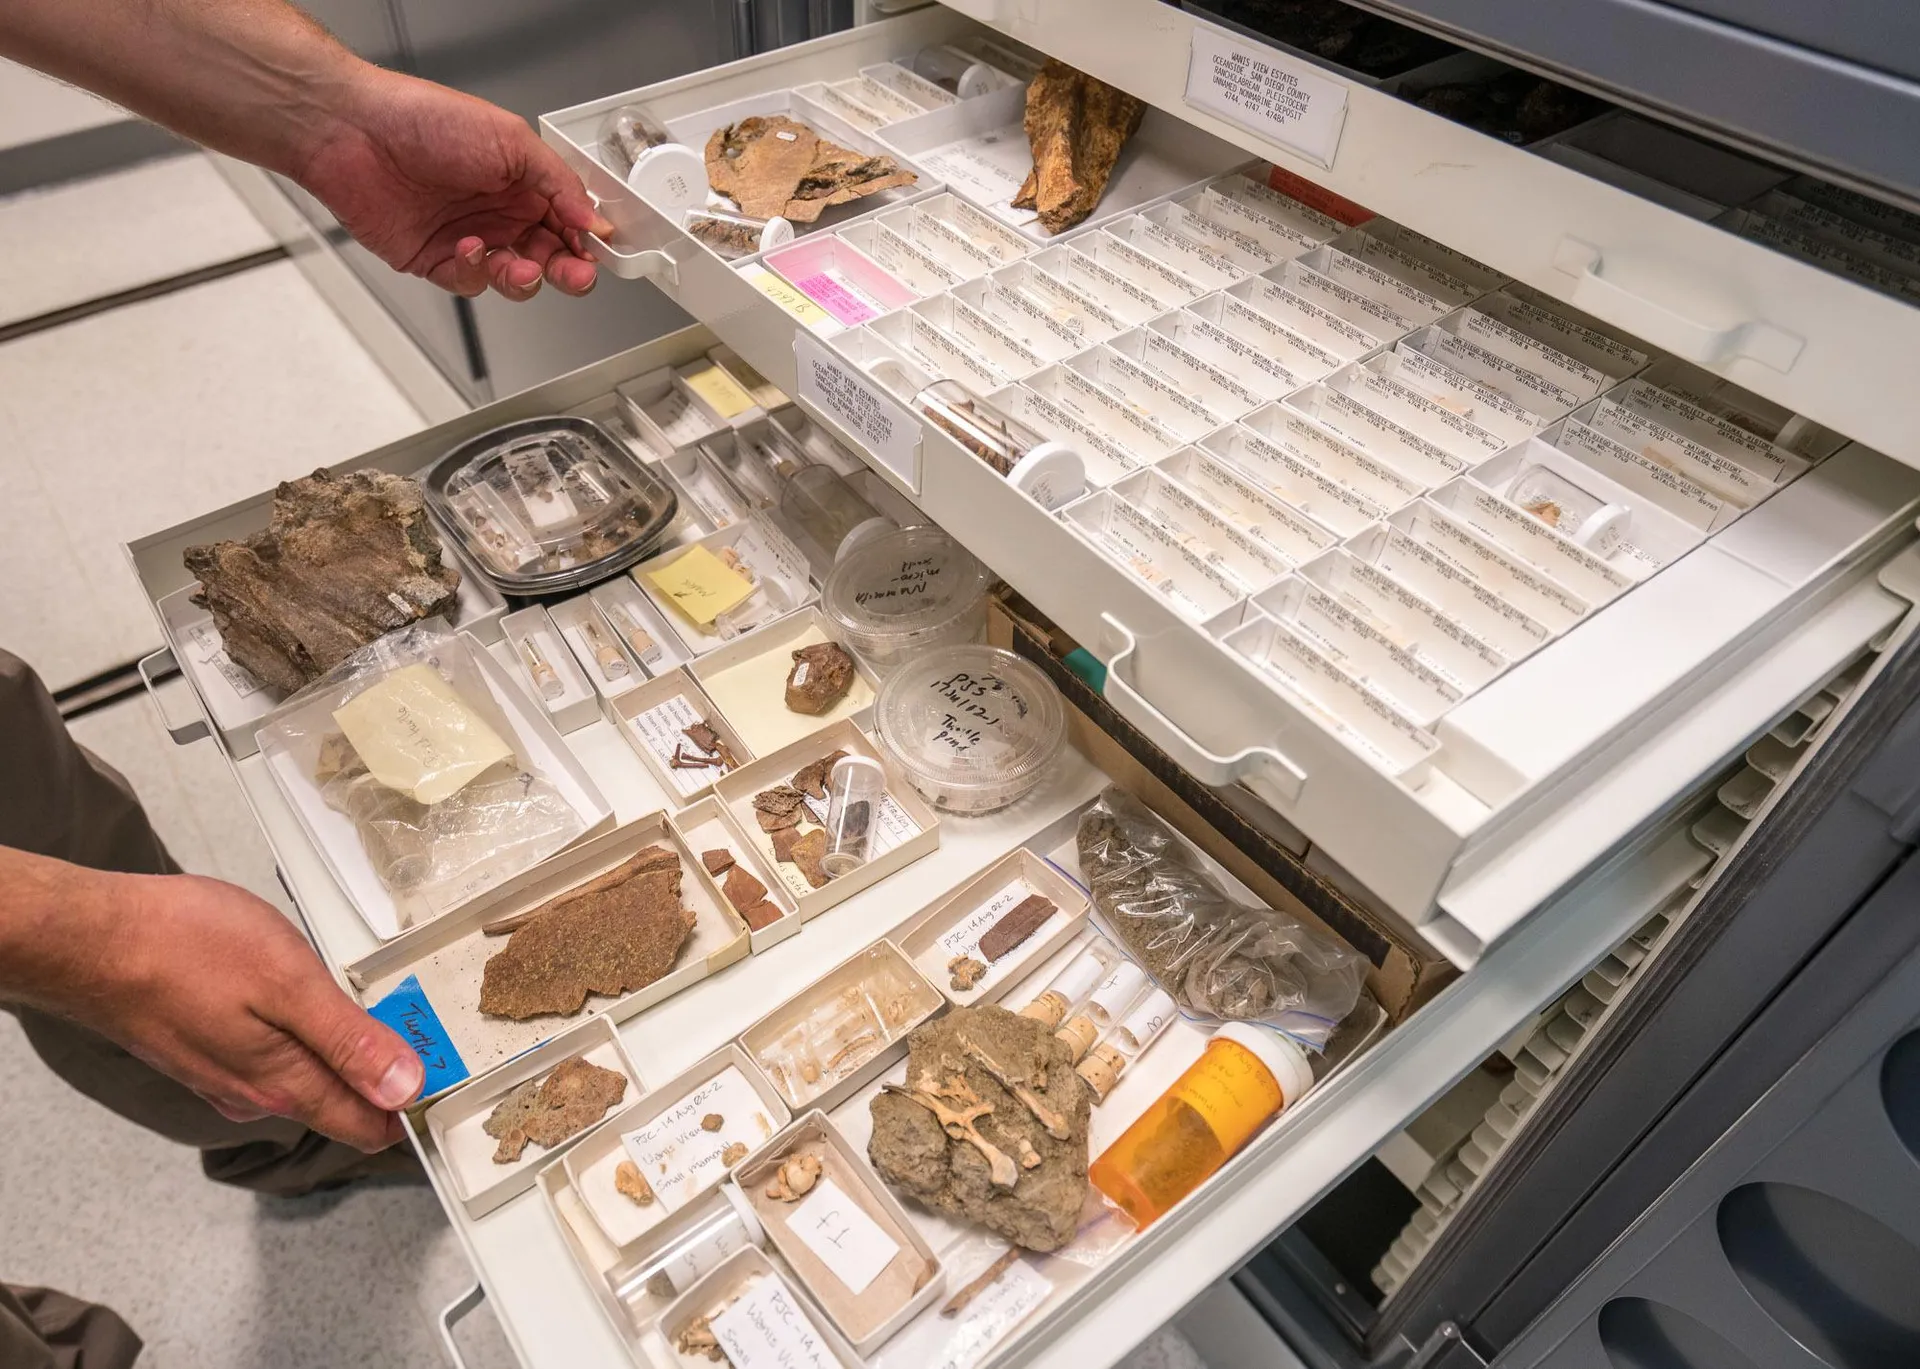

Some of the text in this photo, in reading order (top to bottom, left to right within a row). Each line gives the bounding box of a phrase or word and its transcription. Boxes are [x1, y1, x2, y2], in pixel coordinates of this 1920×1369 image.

[1231, 53, 1297, 87] WANIS VIEW ESTATES
[1250, 70, 1262, 82] SAN
[1264, 76, 1285, 92] DIEGO
[1286, 85, 1310, 103] COUNTY
[1212, 75, 1301, 121] UNNAMED NONMARINE DEPOSIT
[1265, 88, 1308, 113] PLEISTOCENE
[1452, 336, 1462, 344] SAN
[1463, 342, 1479, 353] DIEGO
[1481, 351, 1503, 365] SOCIETY
[1514, 368, 1536, 382] NATURAL
[1539, 380, 1563, 395] HISTORY
[1480, 315, 1490, 323] SAN
[1491, 320, 1507, 332] DIEGO
[1509, 329, 1531, 343] SOCIETY
[1541, 346, 1563, 360] NATURAL
[1566, 358, 1589, 373] HISTORY
[826, 362, 880, 410] WANIS VIEW ESTATES
[843, 383, 853, 397] SAN
[855, 393, 871, 412] DIEGO
[873, 408, 892, 428] COUNTY
[815, 379, 888, 443] UNNAMED NONMARINE DEPOSIT
[857, 405, 891, 437] PLEISTOCENE
[1644, 386, 1773, 452] SAN DIEGO SOCIETY OF NATURAL HISTORY
[1578, 427, 1706, 497] SAN DIEGO SOCIETY OF NATURAL HISTORY
[1614, 405, 1742, 474] SAN DIEGO SOCIETY OF NATURAL HISTORY
